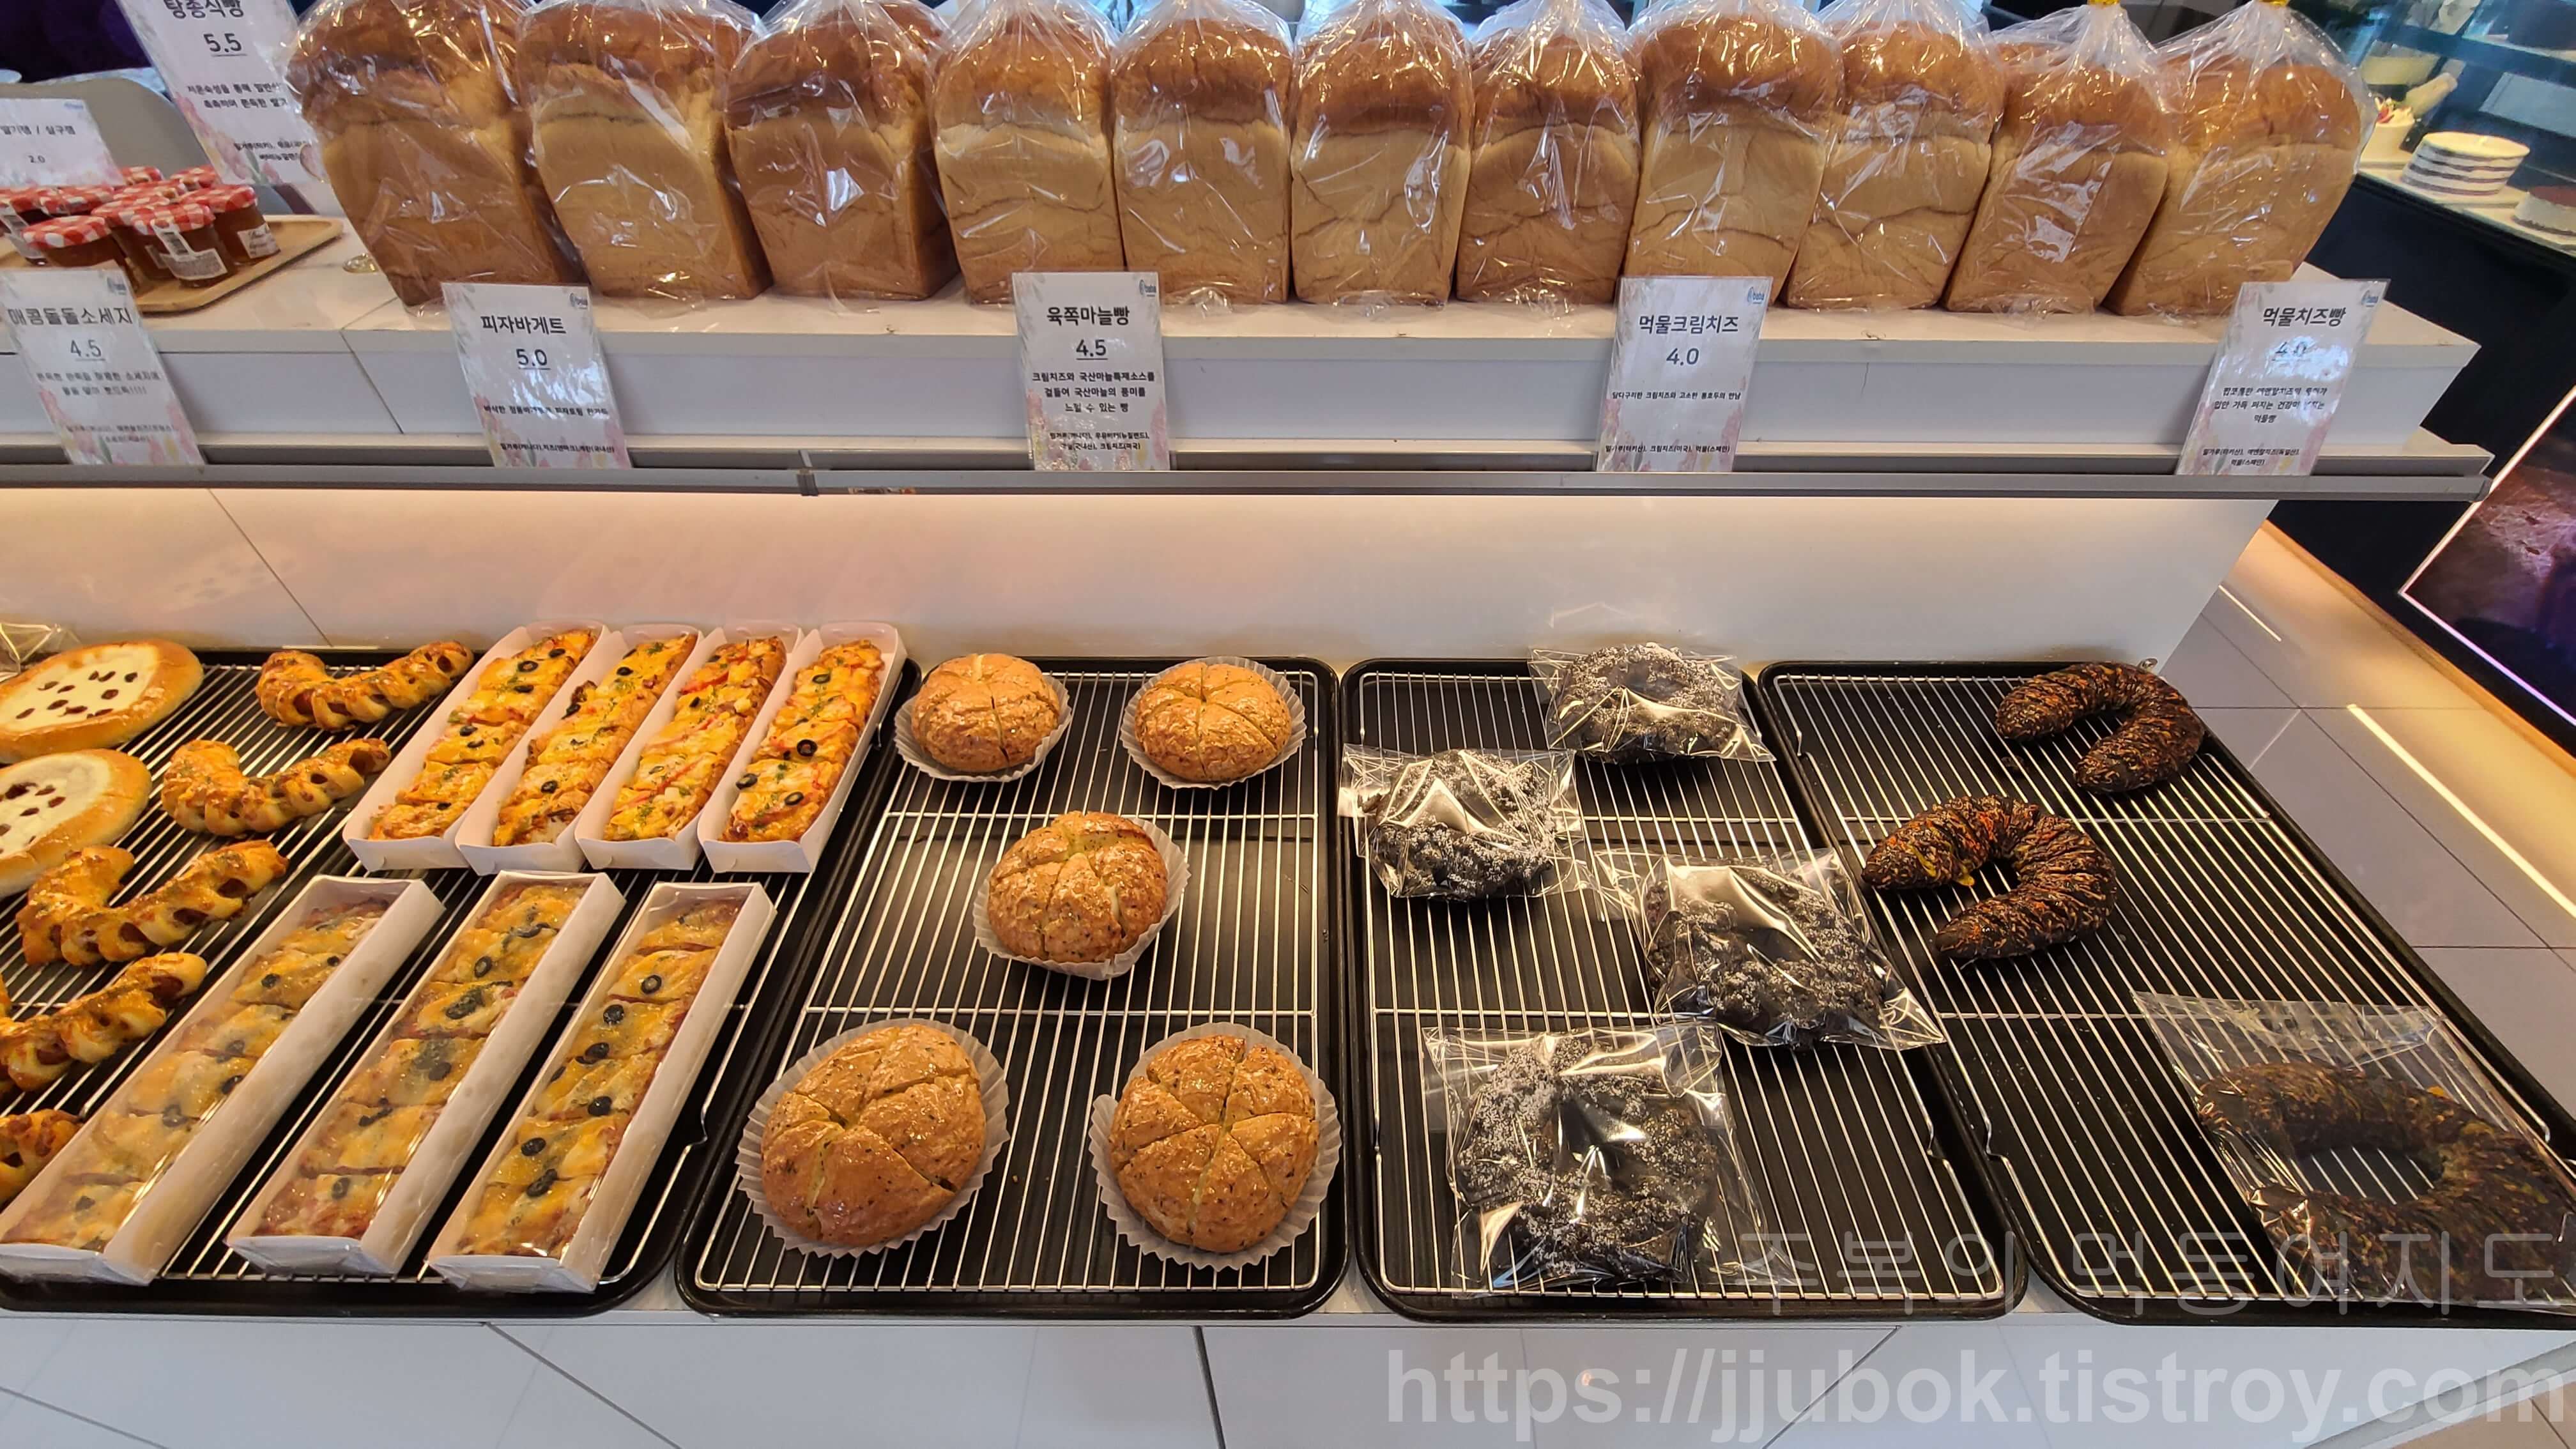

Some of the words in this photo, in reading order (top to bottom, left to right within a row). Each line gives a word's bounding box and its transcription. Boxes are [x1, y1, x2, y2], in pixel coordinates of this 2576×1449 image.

[204, 33, 241, 53] 5.5
[28, 155, 45, 164] 2.0
[480, 314, 566, 334] 피자바게트
[1046, 306, 1130, 326] 육쪽마늘빵
[1639, 315, 1738, 334] 먹물크림치즈
[2263, 307, 2346, 327] 먹물치즈빵
[70, 339, 102, 358] 4.5
[1076, 339, 1107, 357] 4.5
[1666, 348, 1699, 366] 4.0
[516, 349, 548, 367] 5.0
[1032, 372, 1075, 382] 크림치즈와
[1075, 387, 1117, 397] 국산마늘의
[1086, 402, 1095, 413] 수
[1099, 402, 1116, 413] 있는
[1120, 402, 1129, 413] 빵
